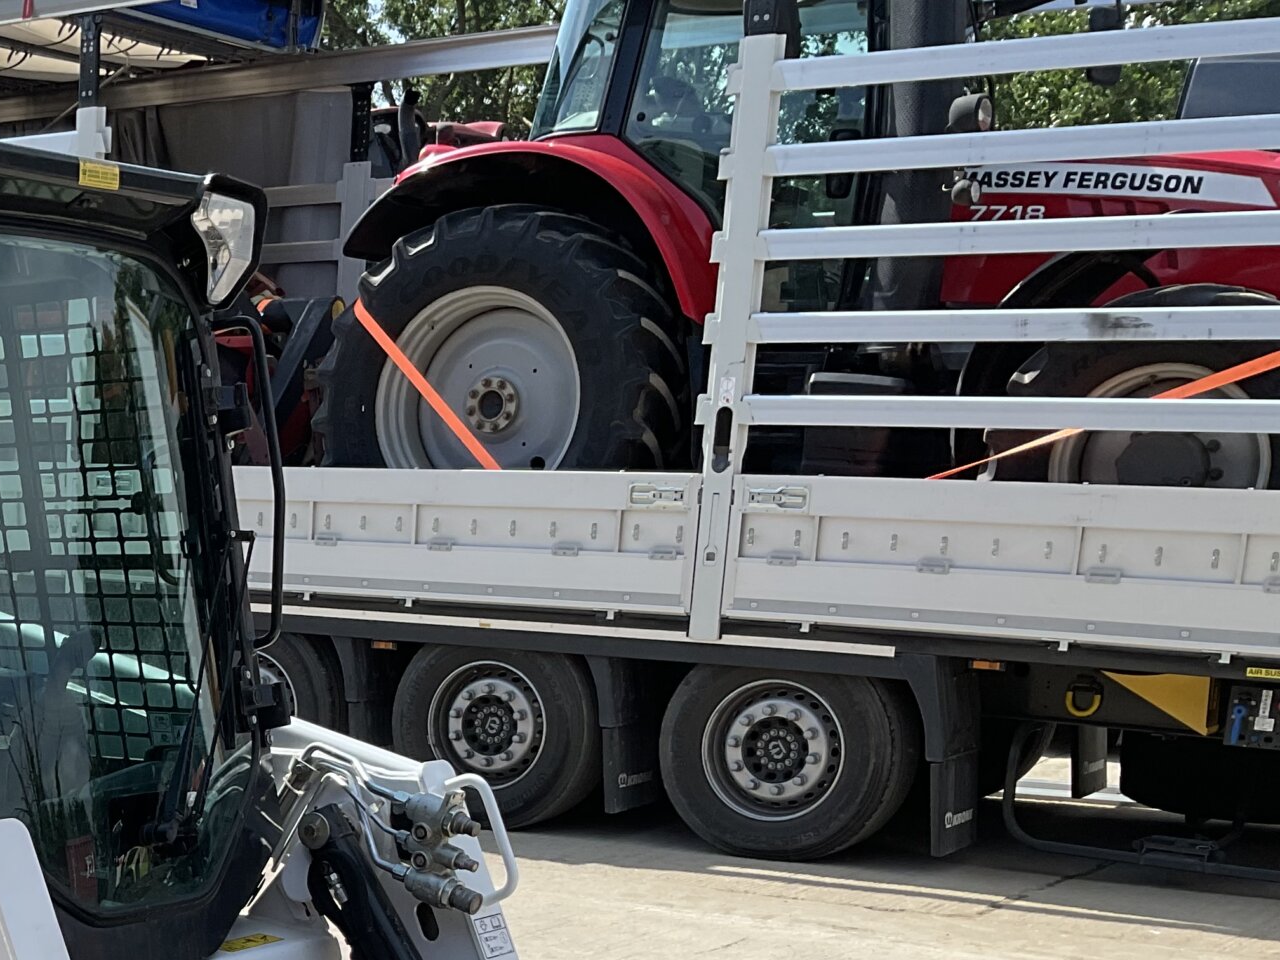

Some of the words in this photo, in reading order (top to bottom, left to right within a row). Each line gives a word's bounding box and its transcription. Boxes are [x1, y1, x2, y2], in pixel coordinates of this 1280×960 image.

[1062, 171, 1204, 195] FERGUSON
[971, 205, 1046, 223] 7718
[1248, 668, 1263, 676] AIR
